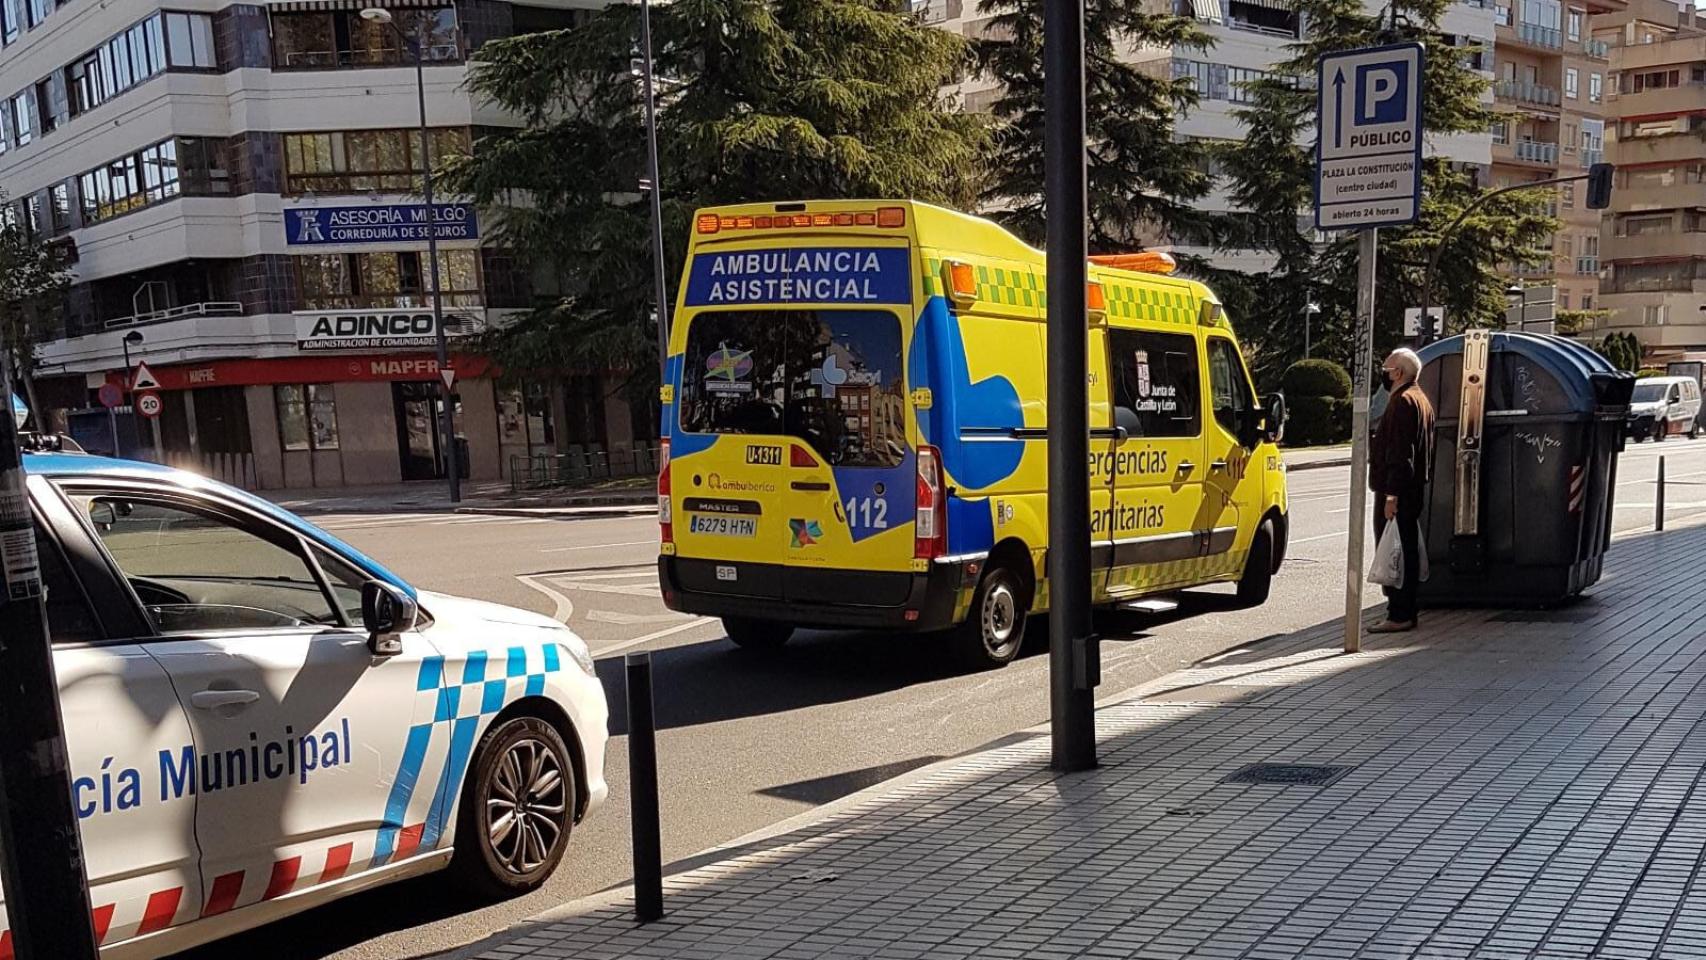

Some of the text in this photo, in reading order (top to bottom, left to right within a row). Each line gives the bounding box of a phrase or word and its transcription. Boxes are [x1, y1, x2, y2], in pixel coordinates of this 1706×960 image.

[1364, 68, 1399, 119] P
[1350, 130, 1412, 148] PÚBLICO
[1322, 160, 1414, 178] PLAZA LA CONSTITUCIÓN
[1335, 179, 1397, 195] (centro ciudad)
[329, 207, 403, 225] ASESORÍA
[1332, 207, 1399, 219] abierto 24 horas
[330, 226, 399, 240] CORREDURÍA
[401, 227, 415, 238] DE
[711, 252, 881, 276] AMBULANCIA
[709, 279, 878, 301] ASISTENCIAL
[310, 314, 434, 336] ADINCO
[370, 337, 381, 347] DE
[1151, 384, 1176, 397] Junta de
[143, 400, 158, 410] 20
[1136, 398, 1177, 415] Castilla y León
[1088, 444, 1168, 485] ergencias
[698, 503, 740, 512] MASTER
[846, 496, 888, 528] 112
[1090, 499, 1164, 533] anitarias
[698, 517, 754, 535] 6279 HTN
[718, 568, 735, 578] SP
[159, 717, 351, 802] Municipal
